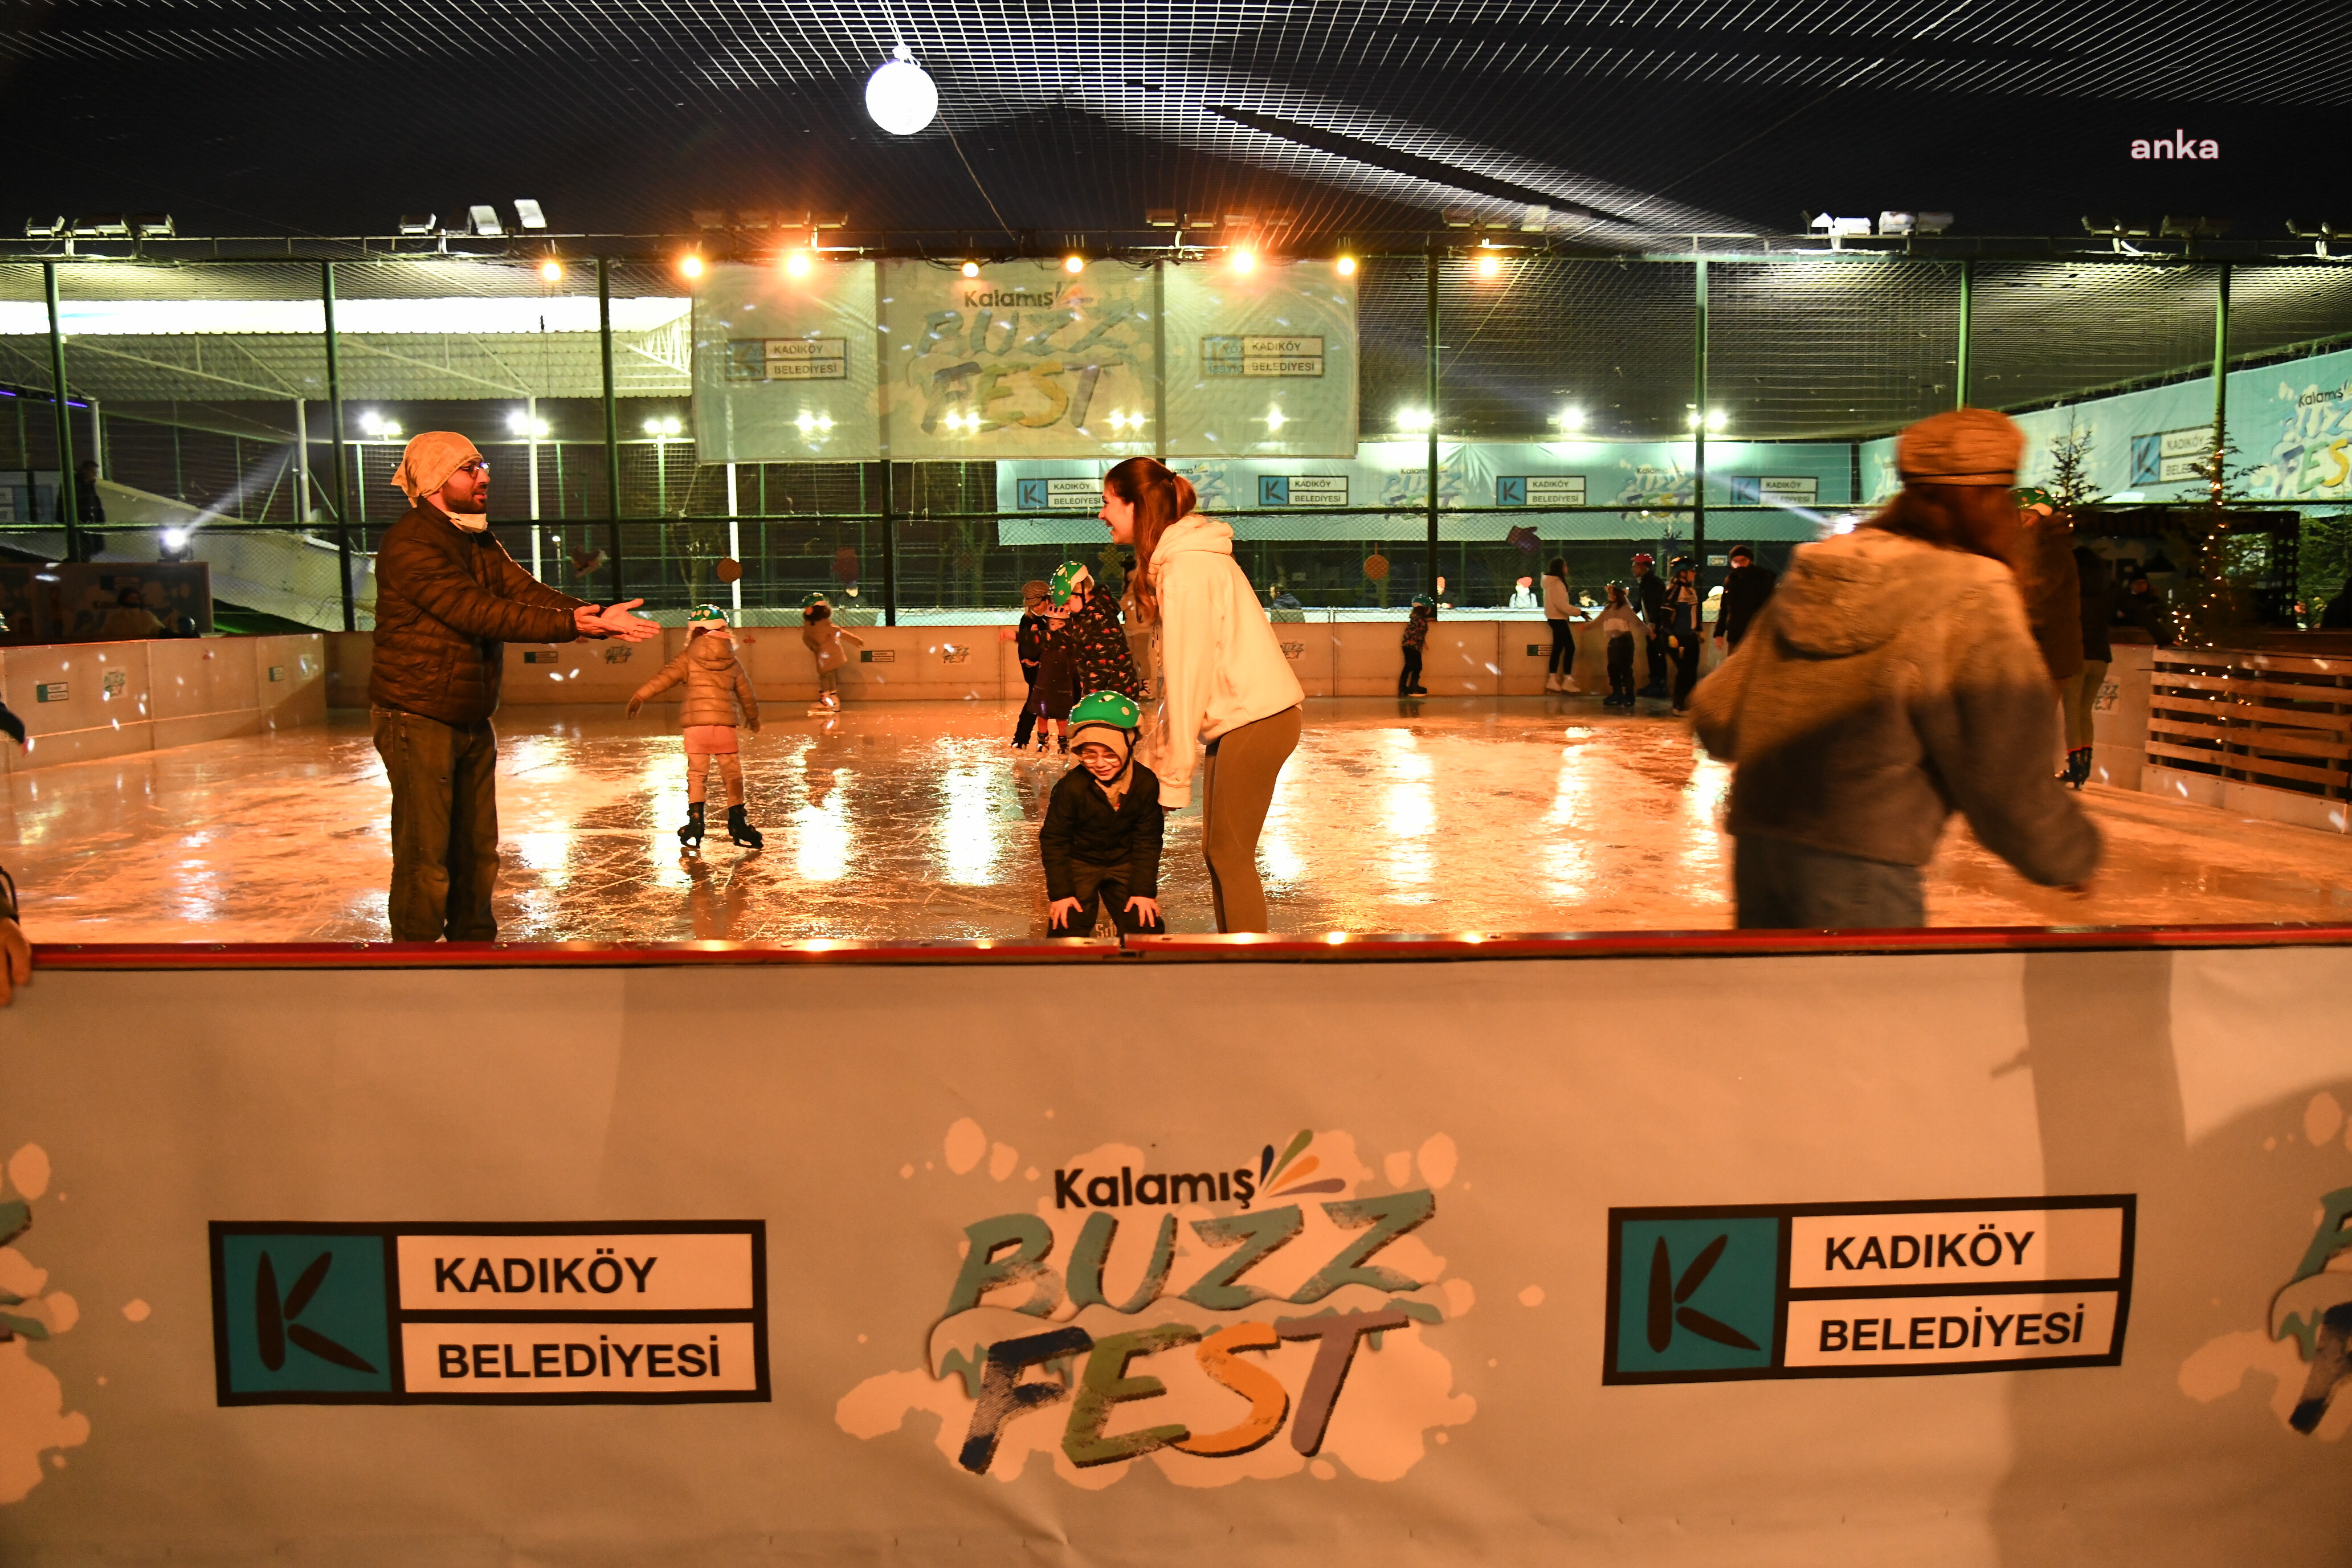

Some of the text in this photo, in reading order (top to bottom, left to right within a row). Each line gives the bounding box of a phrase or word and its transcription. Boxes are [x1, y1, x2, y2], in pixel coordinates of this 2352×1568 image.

[964, 289, 1054, 309] Kalamış
[774, 344, 823, 354] KADIKÖY
[916, 297, 1134, 357] BUZZ
[1252, 341, 1301, 352] KADIKÖY
[774, 363, 837, 374] BELEDİYESİ
[1252, 361, 1314, 371] BELEDİYESİ
[921, 356, 1124, 435] FEST
[2275, 438, 2352, 495] FES
[1055, 1166, 1256, 1209] Kalamış
[943, 1188, 1436, 1319] BUZZ
[1824, 1224, 2035, 1271] KADIKÖY
[434, 1248, 658, 1294] KADIKÖY
[1819, 1302, 2085, 1351] BELEDİYESİ
[437, 1334, 721, 1378] BELEDİYESİ
[958, 1308, 1410, 1475] FEST
